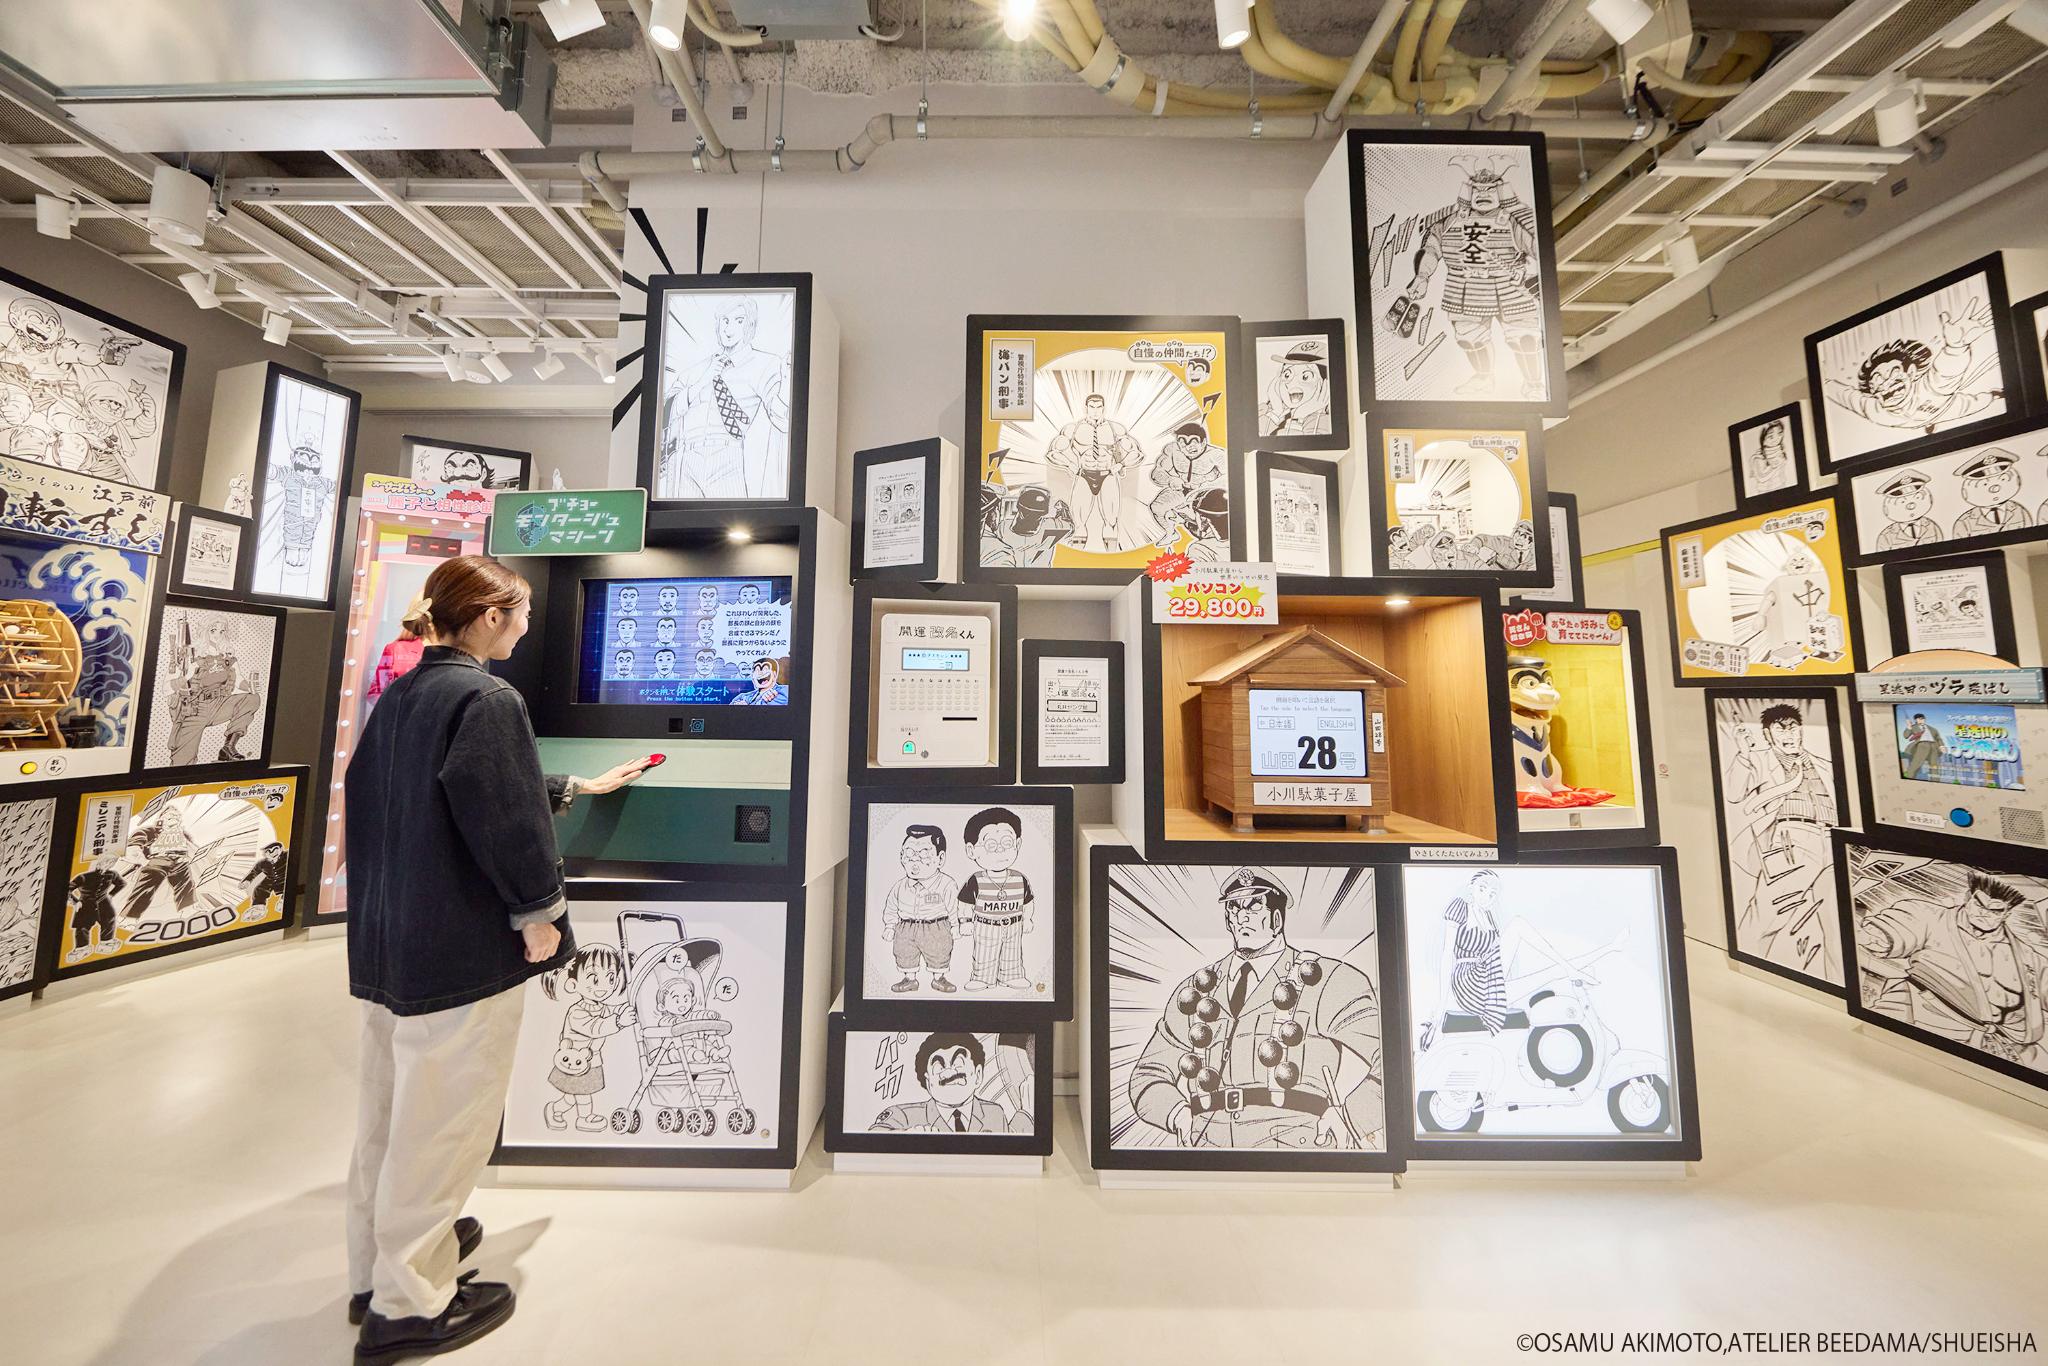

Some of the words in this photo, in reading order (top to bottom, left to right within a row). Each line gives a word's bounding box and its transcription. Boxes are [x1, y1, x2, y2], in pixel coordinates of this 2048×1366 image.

[1459, 221, 1491, 265] 安全
[998, 349, 1010, 409] 海パン刑事
[92, 484, 157, 513] 江戸前
[0, 486, 157, 546] 転ずし
[515, 513, 620, 527] モンタージュ
[549, 530, 615, 544] マシーン
[1187, 583, 1241, 594] パソコン
[1793, 579, 1824, 617] 中
[1170, 597, 1265, 617] 29,800円
[1269, 719, 1292, 729] 日本語
[1320, 719, 1348, 728] ENGLISH
[1267, 786, 1359, 801] 小川駄菓子屋
[984, 902, 1019, 910] MARUI
[129, 906, 237, 942] 2000
[672, 953, 682, 964] だ
[722, 984, 732, 995] だ
